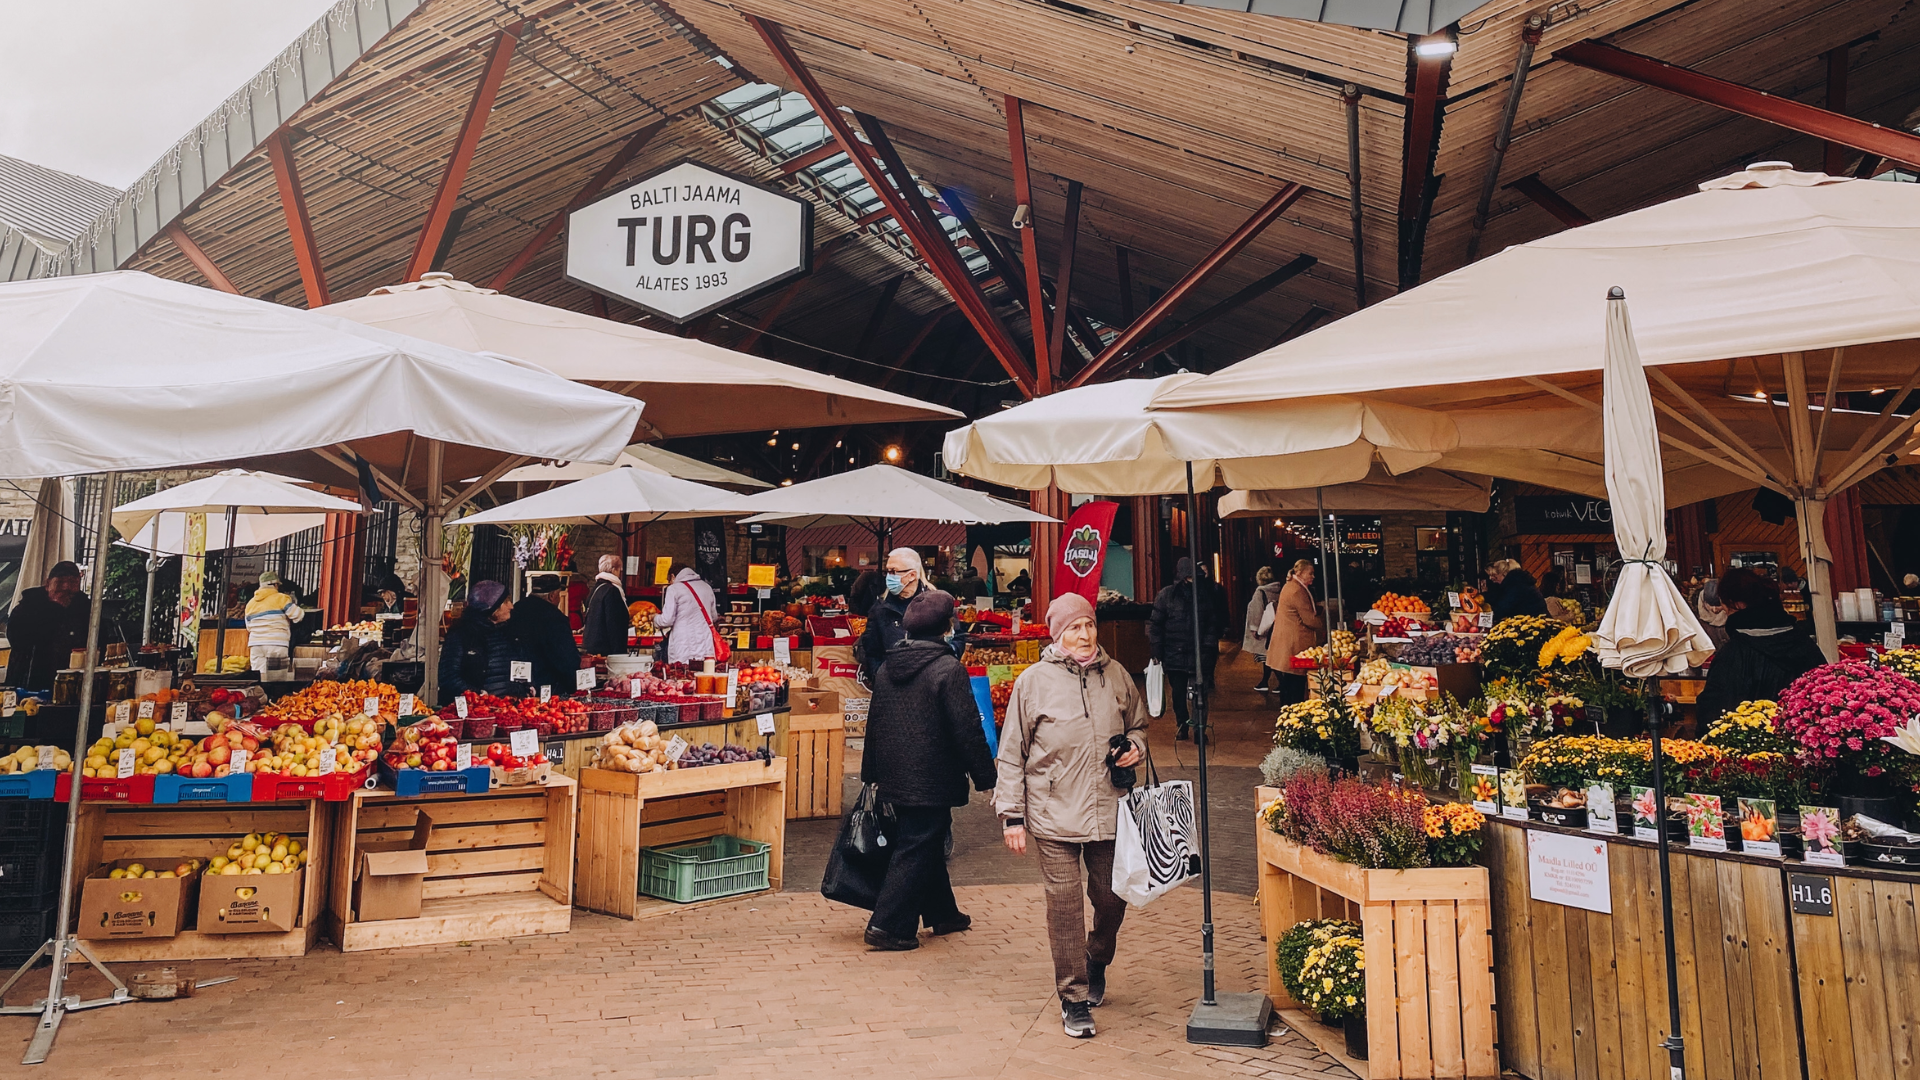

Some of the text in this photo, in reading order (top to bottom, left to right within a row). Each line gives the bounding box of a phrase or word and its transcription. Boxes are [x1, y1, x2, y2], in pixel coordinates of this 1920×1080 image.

[630, 185, 741, 210] BALTI JAAMA
[617, 212, 751, 267] TURG
[636, 271, 729, 291] ALATES 1993
[546, 748, 564, 760] H4.1
[1538, 855, 1598, 873] Maidla Lilled OÜ
[1791, 884, 1832, 905] H1.6
